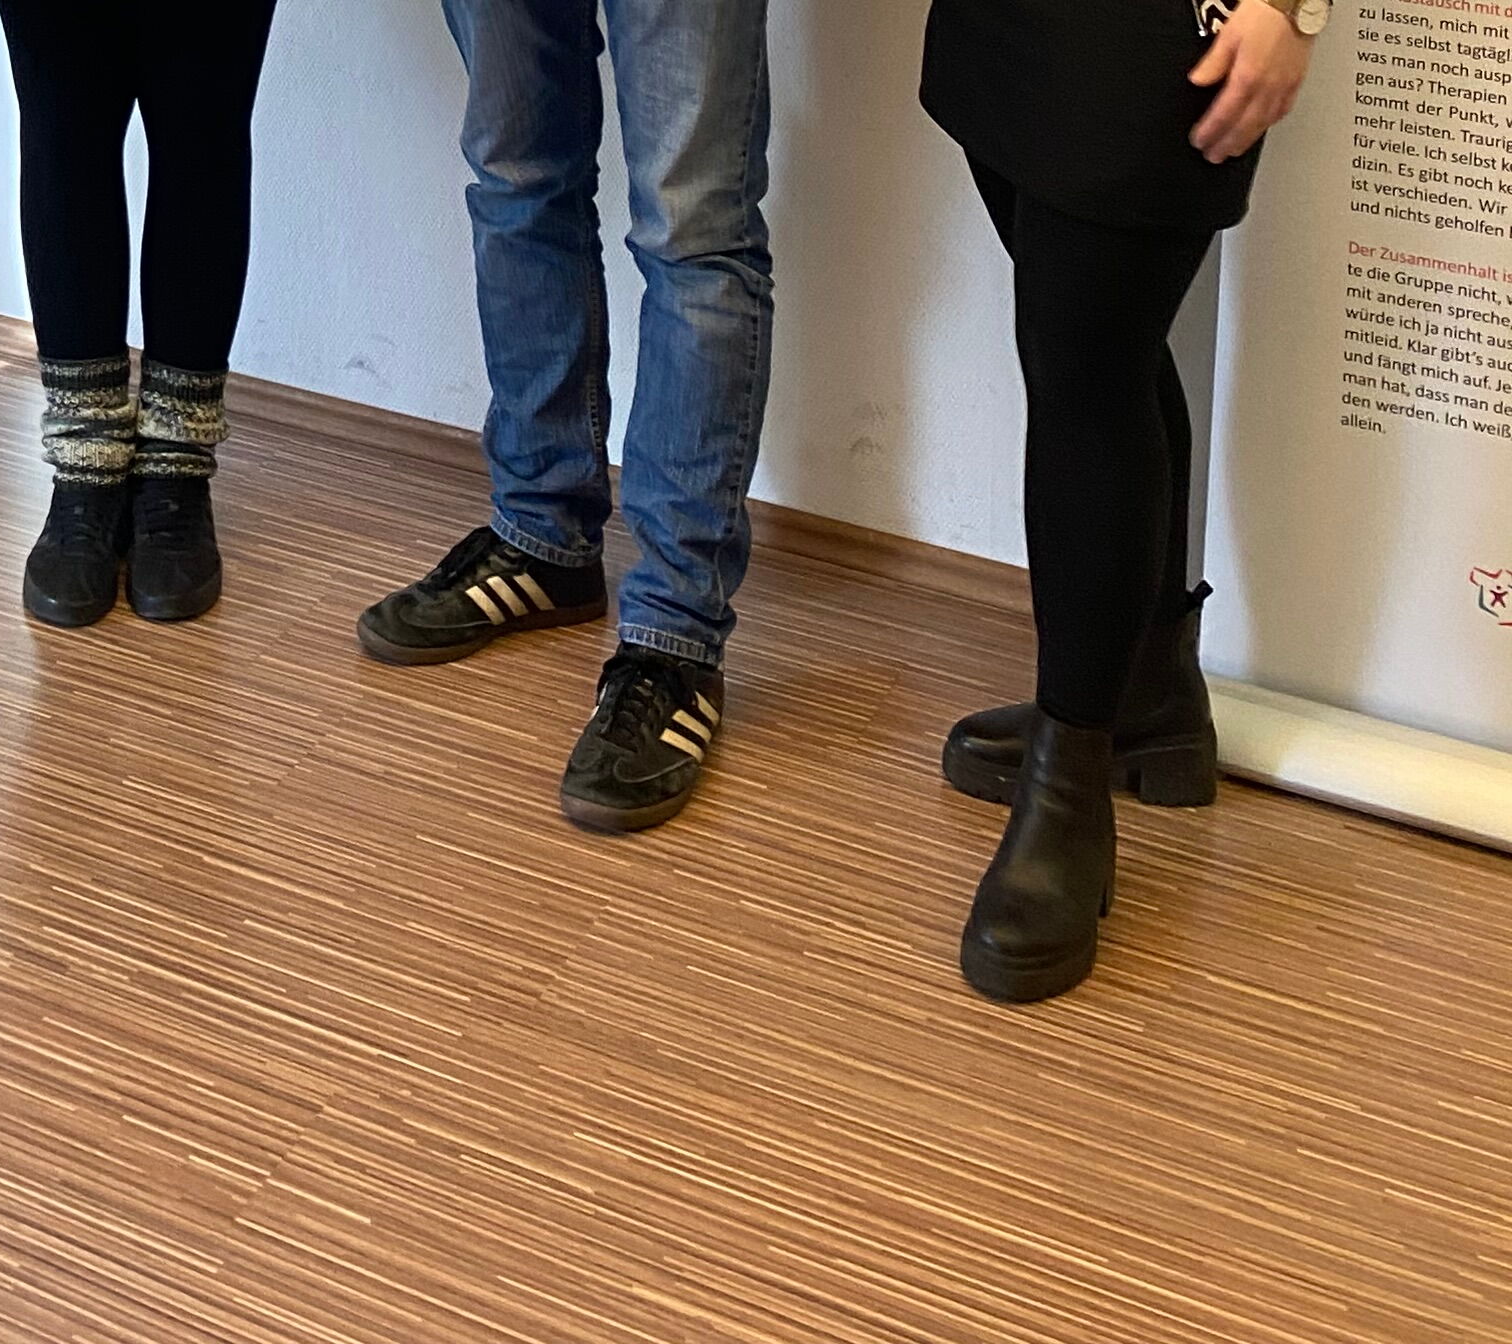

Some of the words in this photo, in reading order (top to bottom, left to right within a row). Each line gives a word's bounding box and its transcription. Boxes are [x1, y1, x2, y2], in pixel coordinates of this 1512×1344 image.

[1359, 8, 1375, 19] zu
[1382, 8, 1433, 30] lassen,
[1440, 18, 1477, 35] mich
[1483, 25, 1509, 39] mit
[1475, 3, 1500, 16] mit
[1356, 91, 1409, 112] kommt
[1416, 101, 1443, 116] der
[1449, 106, 1498, 128] Punkt,
[1351, 200, 1380, 215] und
[1385, 206, 1430, 224] nichts
[1435, 216, 1503, 236] geholfen
[1349, 241, 1376, 257] Der
[1380, 247, 1497, 281] Zusammenhalt
[1347, 263, 1362, 277] te
[1367, 267, 1390, 282] die
[1395, 272, 1454, 294] Gruppe
[1458, 285, 1501, 306] nicht,
[1345, 330, 1402, 350] mitleid.
[1408, 339, 1437, 356] Klar
[1341, 414, 1386, 433] allein.
[1342, 392, 1371, 407] den
[1376, 401, 1439, 423] werden.
[1445, 412, 1467, 429] Ich
